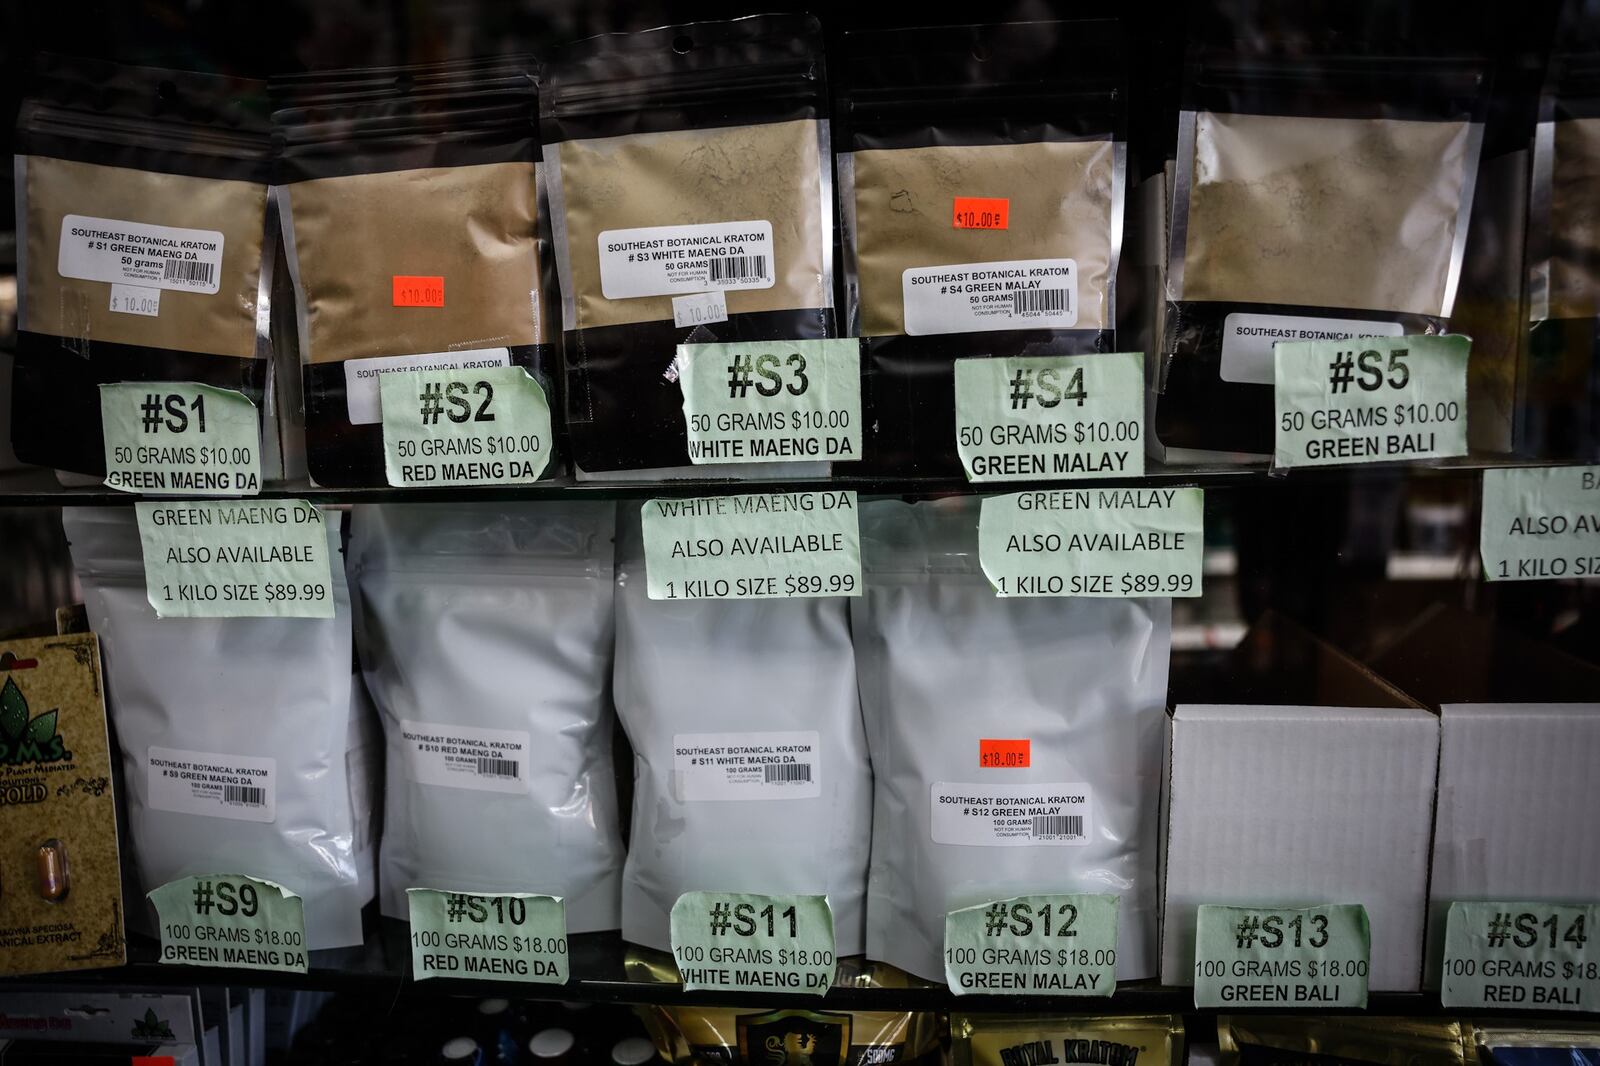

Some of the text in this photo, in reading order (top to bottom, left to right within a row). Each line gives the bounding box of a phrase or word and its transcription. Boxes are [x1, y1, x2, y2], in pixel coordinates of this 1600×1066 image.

[71, 228, 216, 251] SOUTHEAST BOTANICAL KRATOM
[608, 233, 765, 252] SOUTHEAST BOTANICAL KRATOM
[96, 242, 197, 260] S1 GREEN MAENG DA
[637, 247, 744, 262] S3 WHITE MAENG DA
[121, 257, 163, 269] 50 grams
[665, 261, 708, 270] 50 GRAMS
[911, 268, 1069, 285] SOUTHEAST BOTANICAL KRATOM
[950, 280, 1041, 294] S4 GREEN MALAY
[982, 294, 1013, 302] GRAMS
[1236, 327, 1297, 338] SOUTHEAST
[463, 360, 502, 369] KRATOM
[1330, 349, 1409, 394] #S5
[728, 353, 809, 398] #S3
[1010, 368, 1087, 409] #S4
[141, 394, 205, 433] #S1
[419, 381, 495, 425] #S2
[691, 410, 849, 432] 50 GRAMS $10.00
[1282, 402, 1458, 432] 50 GRAMS $10.00
[960, 421, 1139, 446] 50 GRAMS $10.00
[115, 447, 250, 466] 50 GRAMS $10.00
[398, 435, 539, 457] 50 GRAMS $10.00
[690, 437, 852, 458] WHITE MAENG DA
[1306, 433, 1434, 459] GREEN BALI
[402, 461, 534, 482] RED MAENG DA
[972, 452, 1128, 475] GREEN MALAY
[109, 471, 258, 489] GREEN MAENG DA
[657, 492, 852, 517] WHITE MAENG DA
[1018, 490, 1175, 510] GREEN MALAY
[153, 507, 320, 526] GREEN MAENG DA
[1509, 516, 1568, 535] ALSO
[672, 533, 843, 558] ALSO AVAILABLE
[1006, 533, 1185, 552] ALSO AVAILABLE
[167, 546, 314, 563] ALSO AVAILABLE
[1499, 558, 1567, 577] 1 KILO
[179, 582, 325, 603] KILO SIZE $89.99
[685, 574, 854, 598] KILO SIZE $89.99
[1017, 572, 1193, 595] KILO SIZE $89.99
[150, 759, 191, 769] SOUTHEAST
[193, 764, 234, 773] BOTANICAL
[939, 796, 1084, 805] SOUTHEAST BOTANICAL KRATOM
[972, 807, 1060, 816] S12 GREEN MALAY
[193, 881, 258, 917] #S9
[448, 894, 525, 925] #S10
[710, 903, 796, 937] #S11
[985, 904, 1078, 936] #S12
[1488, 913, 1587, 948] #S14
[166, 924, 300, 945] 100 GRAMS $18.00
[1236, 915, 1329, 948] #S13
[413, 931, 566, 954] 100 GRAMS $18.00
[164, 945, 305, 967] GREEN MAENG DA
[424, 955, 559, 977] RED MAENG DA
[676, 946, 832, 966] 100 GRAMS $18.00
[946, 948, 1115, 967] 100 GRAMS $18.00
[1196, 961, 1367, 978] 100 GRAMS $18.00
[1445, 959, 1555, 978] 100 GRAMS
[736, 970, 800, 987] MAENG
[807, 973, 827, 990] DA
[960, 972, 1100, 989] GREEN MALAY
[1221, 985, 1339, 1001] GREEN BALI
[1484, 985, 1580, 1004] RED BALI
[1064, 1039, 1138, 1066] KRATOM
